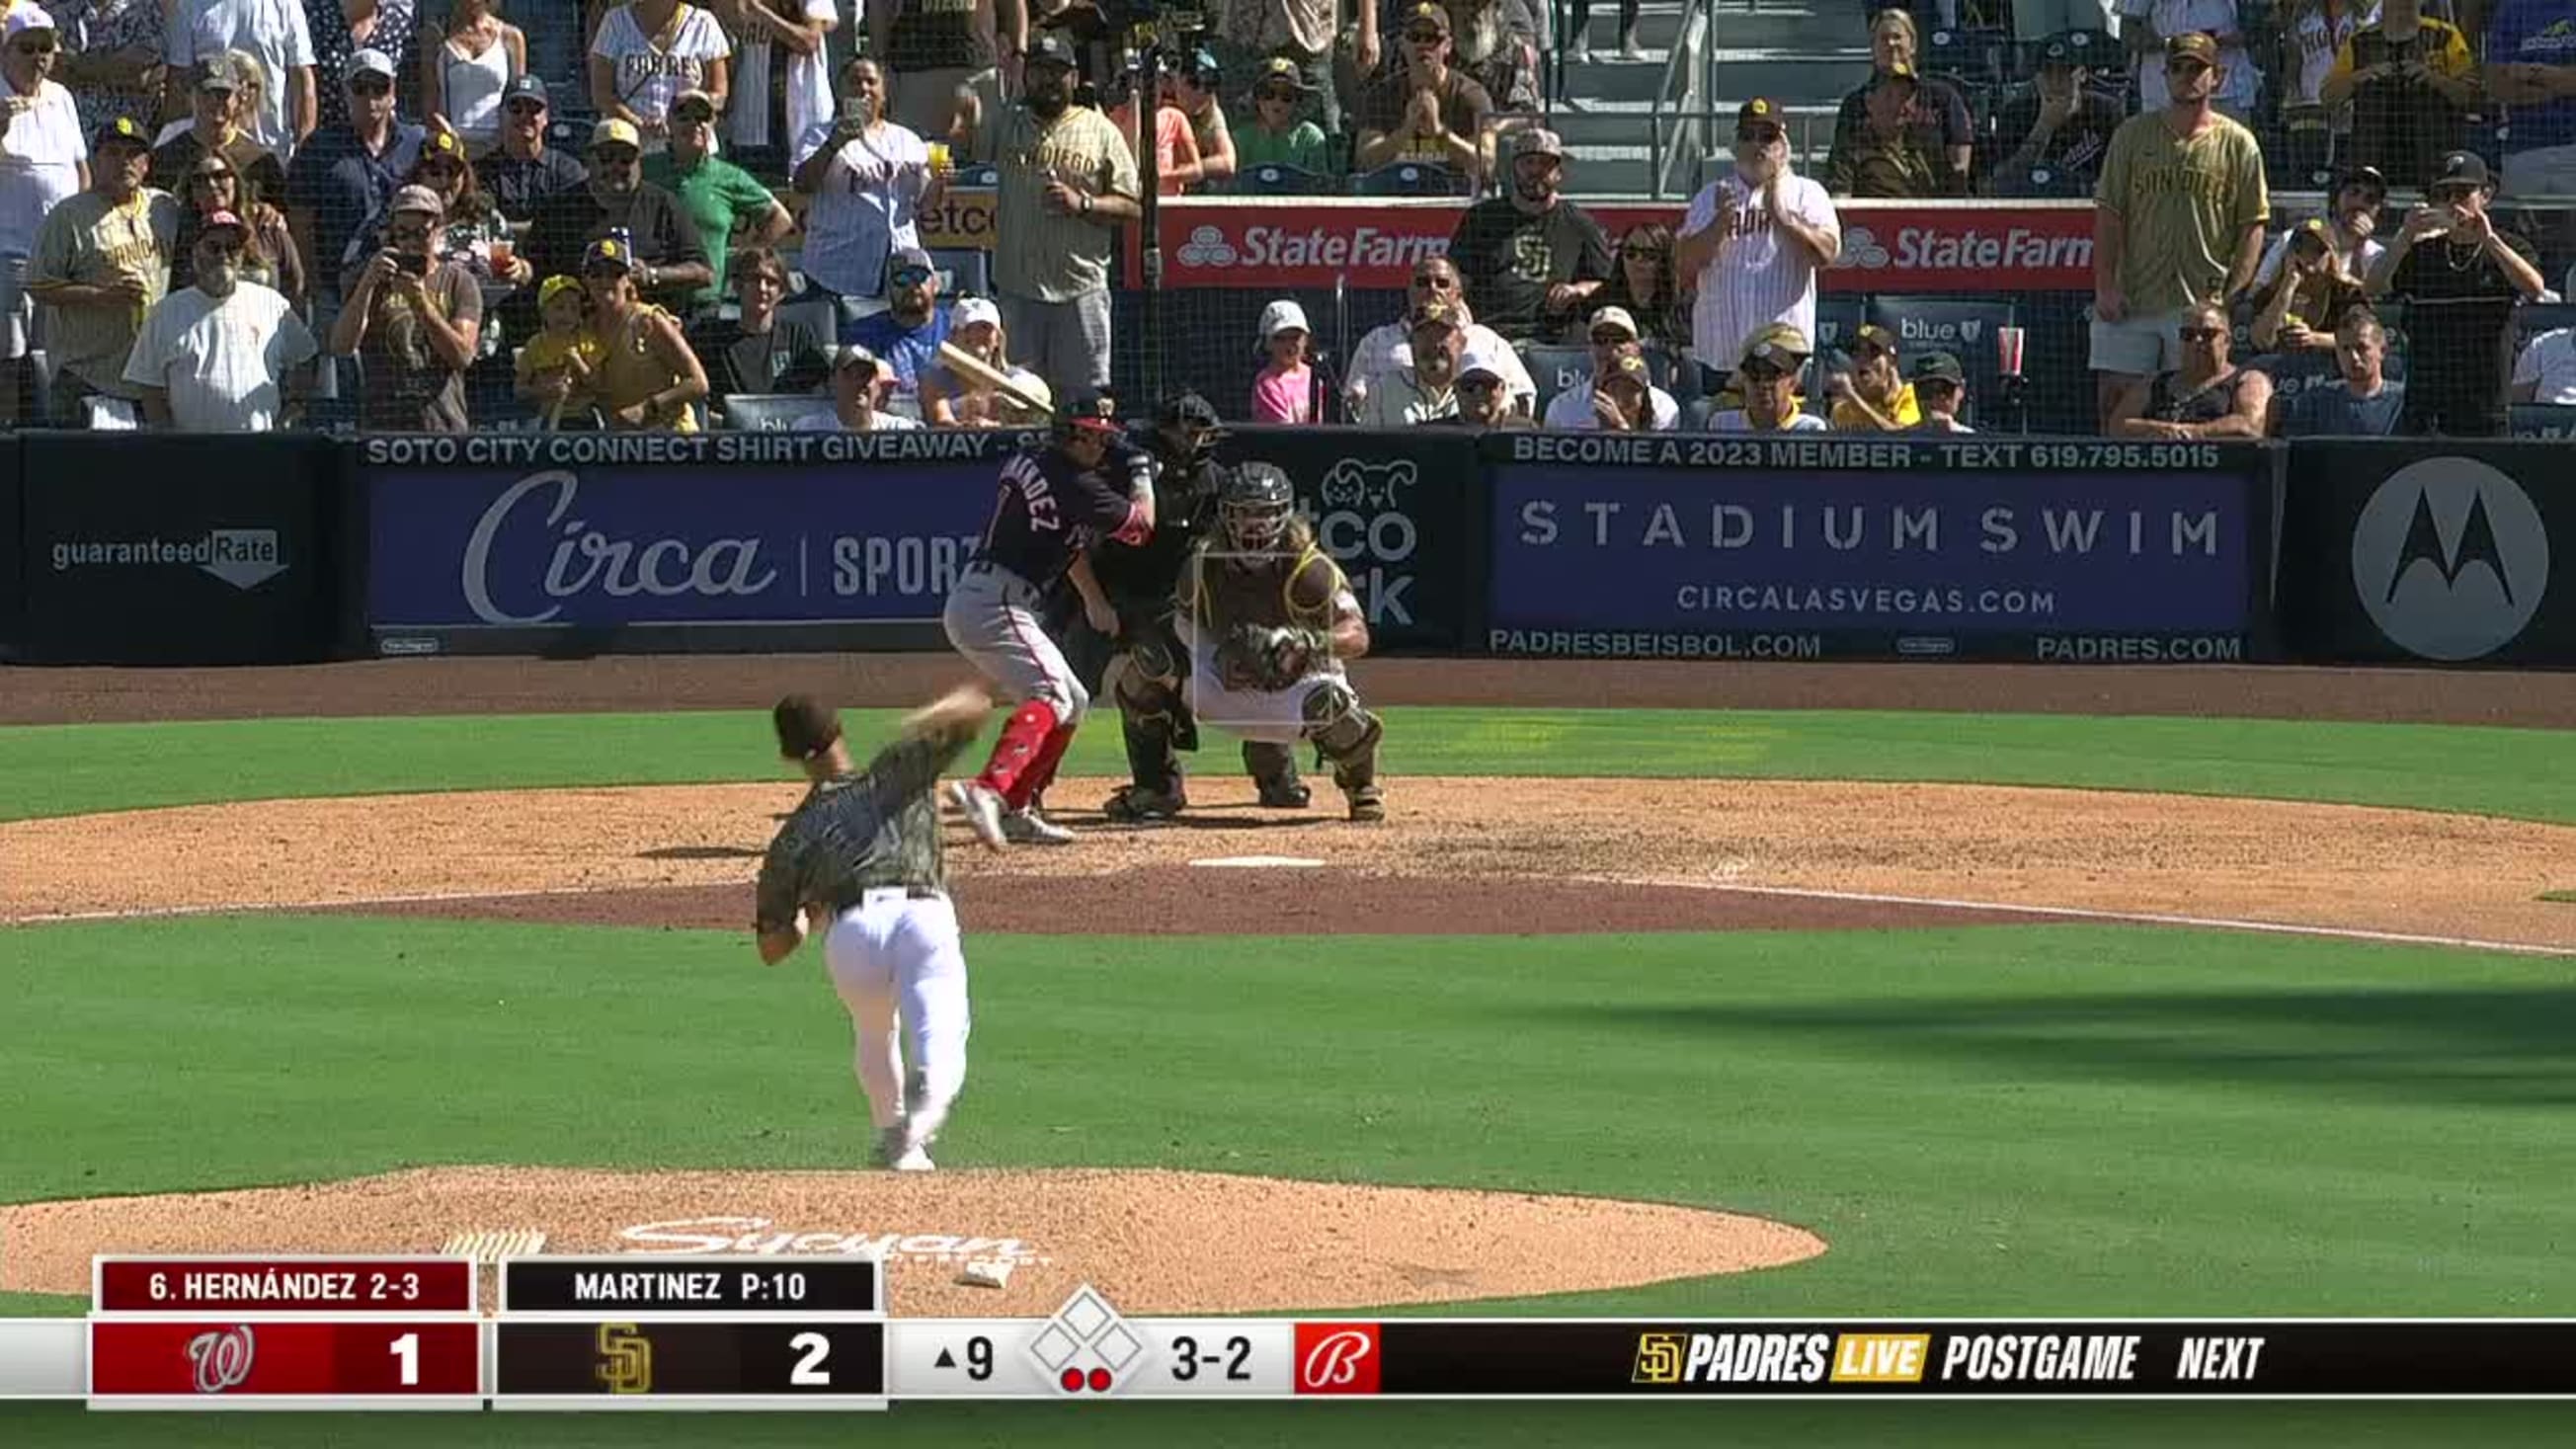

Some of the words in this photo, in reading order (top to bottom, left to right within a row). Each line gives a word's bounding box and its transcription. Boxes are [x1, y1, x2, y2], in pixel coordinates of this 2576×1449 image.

[1900, 317, 1956, 340] blue
[367, 438, 456, 463] SOTO
[466, 437, 541, 462] CITY
[549, 437, 708, 462] CONNECT
[716, 437, 815, 461] SHIRT
[822, 434, 989, 460] GIVEAWAY
[1513, 436, 1652, 462] BECOME
[1659, 441, 1681, 464] A
[1688, 442, 1761, 466] 2023
[1770, 443, 1911, 468] MEMBER
[1943, 443, 2023, 468] TEXT
[2030, 444, 2219, 468] 619.795.5015
[1521, 500, 1939, 551] STADIUM
[1979, 507, 2217, 555] SWIM
[52, 536, 210, 570] guaranteed
[215, 536, 276, 562] Rate
[462, 476, 777, 624] Circa
[1677, 585, 2054, 613] CIRCALASVEGAS.COM
[1489, 629, 1821, 657] PADRESBEISBOL.COM
[2037, 636, 2241, 661] PADRES.COM
